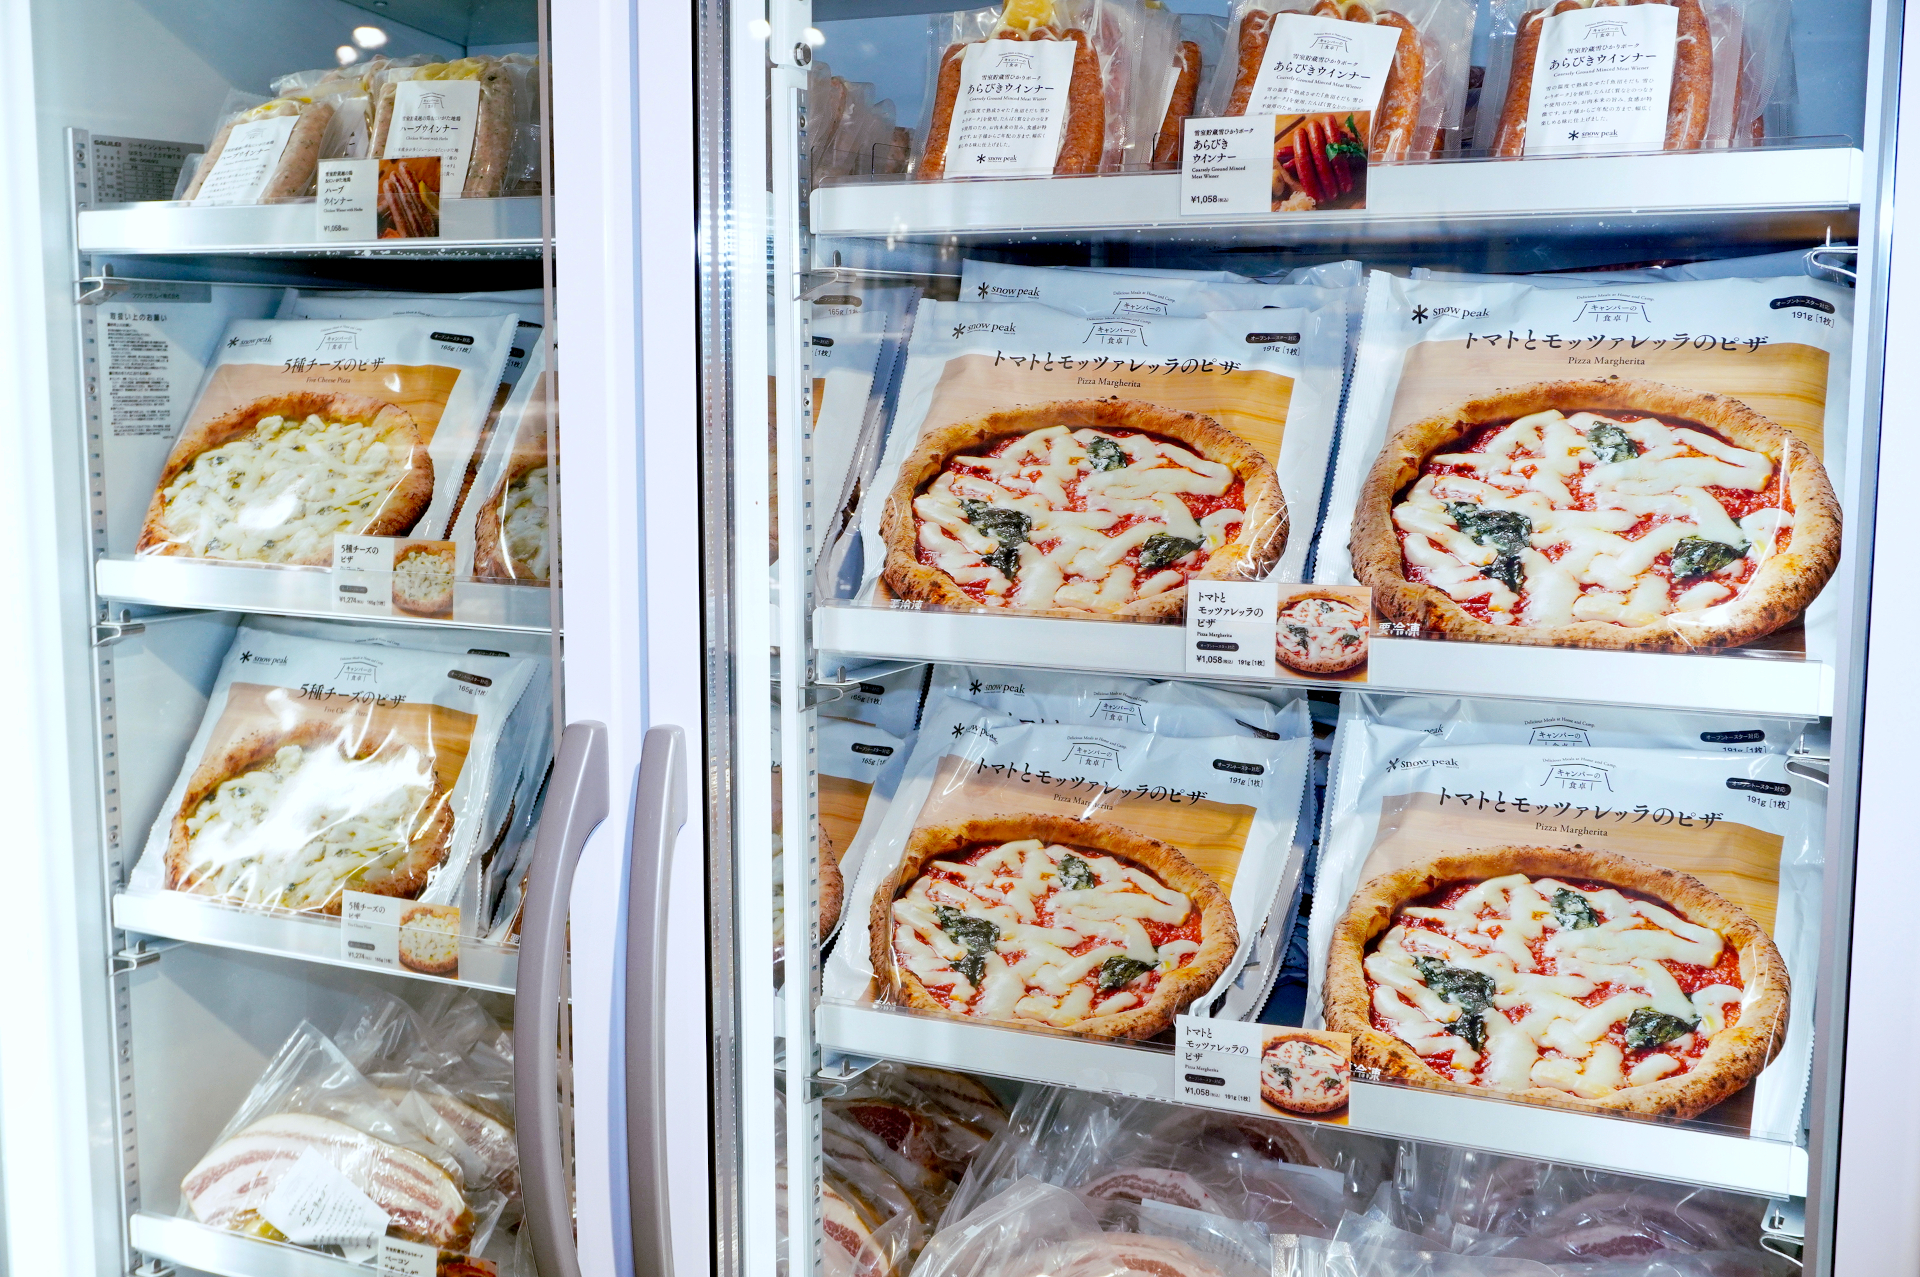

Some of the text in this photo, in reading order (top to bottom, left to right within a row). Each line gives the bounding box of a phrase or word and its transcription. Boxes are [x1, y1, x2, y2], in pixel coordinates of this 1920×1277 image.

[1549, 52, 1657, 71] あらびきウインナー
[1274, 60, 1371, 80] あらびきウインナー
[1276, 74, 1295, 82] Coarsely
[967, 83, 1055, 95] あらびきウインナー
[1600, 130, 1618, 138] peak
[1194, 138, 1228, 150] あらびき
[1003, 154, 1017, 163] peak
[1193, 153, 1236, 164] ウインナー
[324, 186, 345, 194] ハーブ
[324, 196, 353, 206] ウインナー
[991, 285, 1040, 298] snow peak
[828, 308, 844, 316] 165g
[1432, 306, 1490, 319] snow peak
[1602, 314, 1622, 322] 食卓
[1791, 311, 1835, 328] 191g [1枚]
[967, 322, 1016, 334] snow peak
[256, 335, 272, 345] peak
[1107, 336, 1123, 345] 食卓
[1466, 329, 1769, 355] トマトとモッツァレッラのピザ
[440, 344, 455, 352] 165g
[281, 357, 386, 374] 5種チーズのピザ
[994, 350, 1242, 376] トマトとモッツァレッラのピザ
[1568, 356, 1646, 367] Pizza Margherita
[1077, 376, 1141, 389] Pizza Margherita
[340, 544, 379, 554] 5種チーズの
[1198, 592, 1226, 603] トマトと
[1198, 606, 1264, 618] モッツァレッラの
[1197, 618, 1216, 628] ピザ
[1378, 622, 1421, 636] 要冷凍
[253, 656, 288, 666] snow peak
[458, 684, 474, 694] 165g
[984, 684, 1026, 694] snow peak
[298, 683, 406, 708] 5種チーズのピザ
[1524, 718, 1542, 726] Delicious
[1706, 732, 1760, 740] オーブントースター対応
[862, 758, 876, 766] 165g
[1086, 758, 1100, 766] 食卓
[1400, 758, 1459, 769] snow peak
[977, 757, 1208, 806] トマトとモッツァレッラのピザ
[1229, 777, 1246, 786] 191g
[1568, 781, 1587, 790] 食卓
[1053, 794, 1072, 804] Pizza
[1746, 795, 1790, 810] 191g [1枚]
[1439, 786, 1724, 830] トマトとモッツァレッラのピザ
[1535, 822, 1608, 837] Pizza Margherita
[348, 902, 386, 914] 5種チーズの
[1186, 1026, 1212, 1038] トマトと
[1186, 1040, 1249, 1055] モッツァレッラの
[1185, 1052, 1204, 1062] ピザ
[1350, 1064, 1382, 1082] 冷凍
